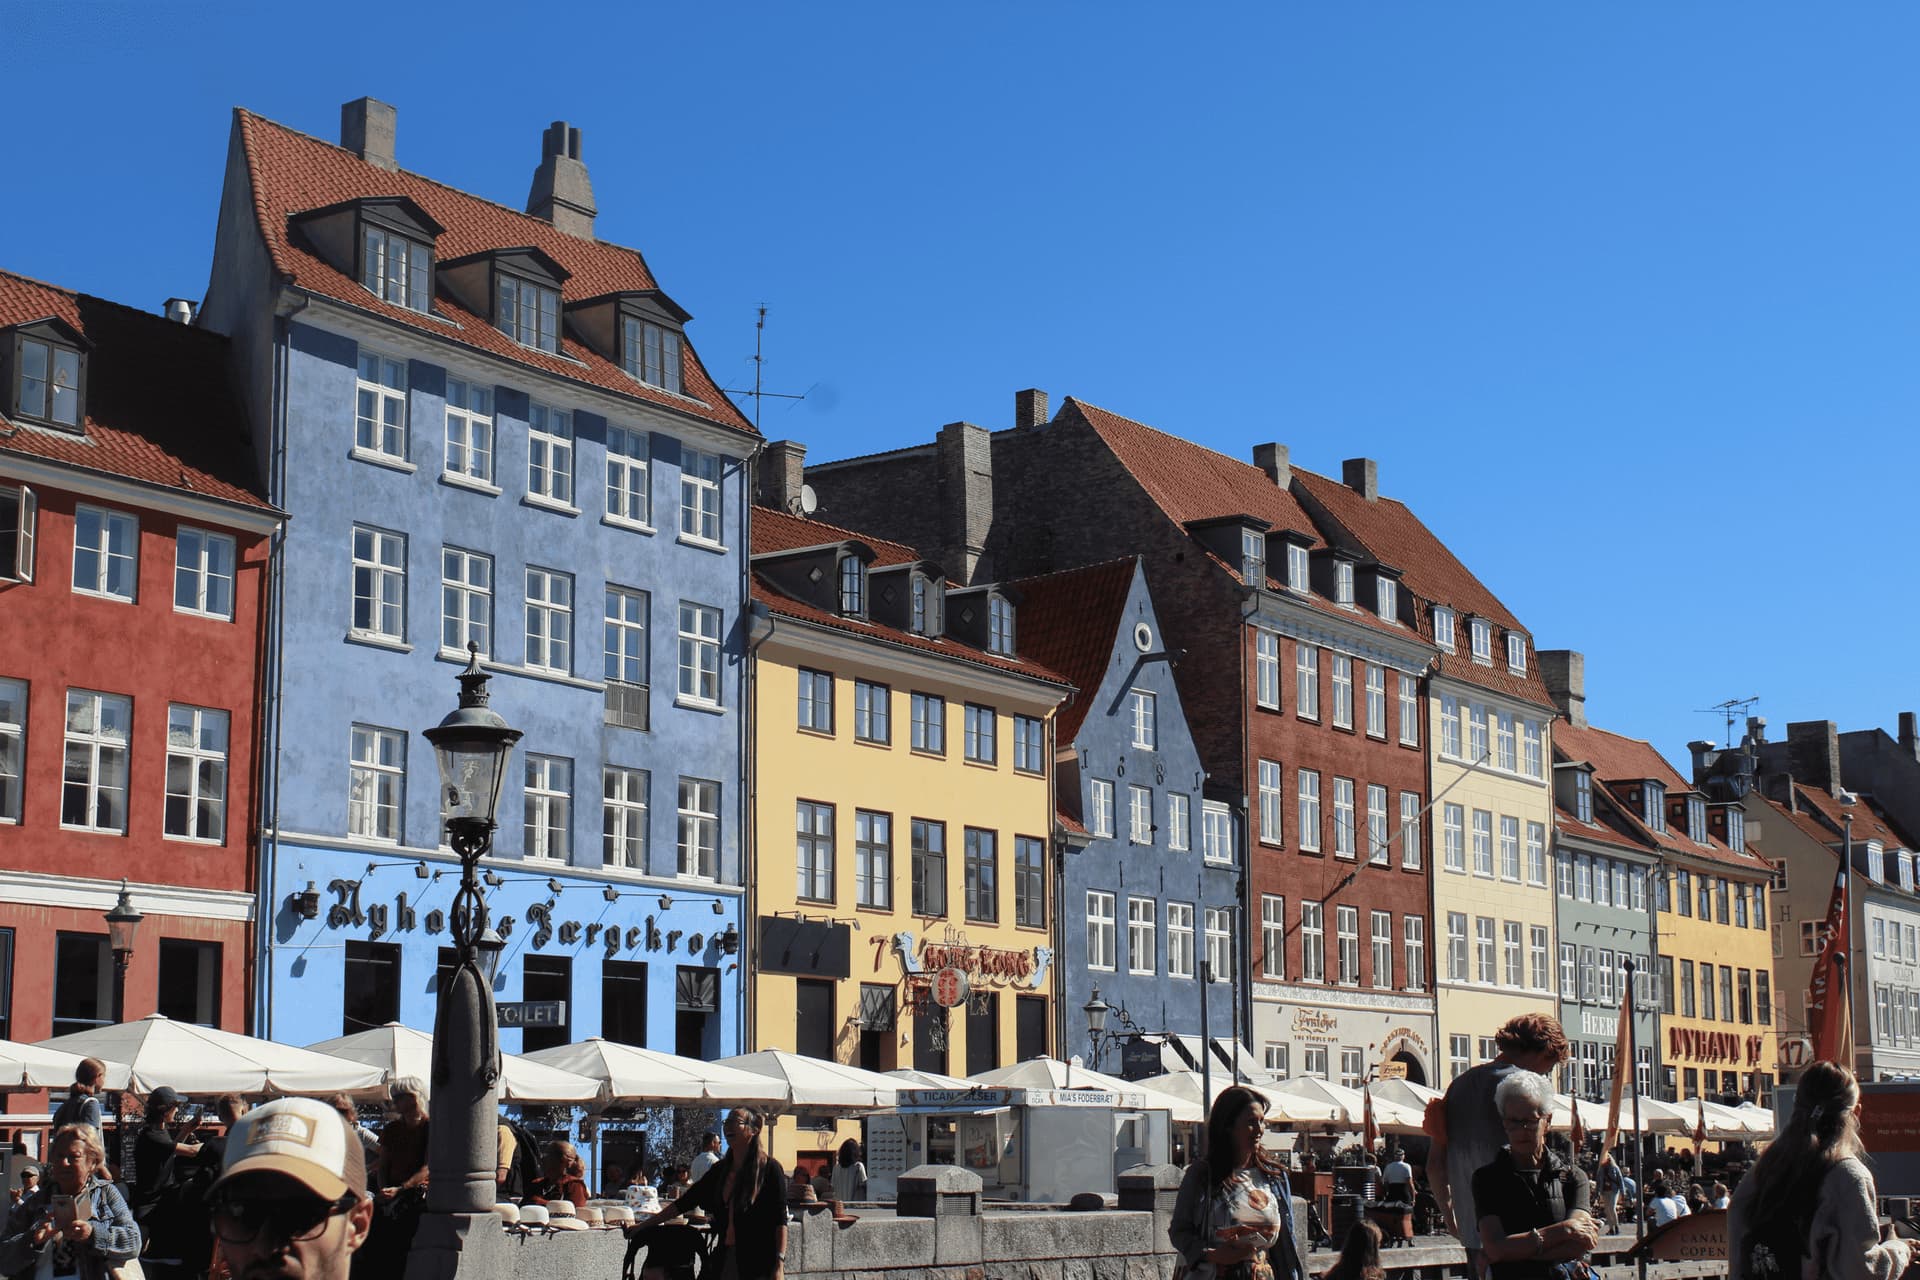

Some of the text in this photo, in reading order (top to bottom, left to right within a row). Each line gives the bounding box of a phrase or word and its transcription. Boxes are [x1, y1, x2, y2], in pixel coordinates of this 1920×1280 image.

[327, 879, 515, 941] Nyhas
[869, 935, 888, 972] 7
[1669, 1027, 1763, 1063] NYHAVN 17
[1781, 1041, 1804, 1066] 17
[923, 1092, 954, 1101] TICAN
[1060, 1093, 1076, 1102] MIA'S
[1681, 1233, 1726, 1243] CANAL
[1680, 1247, 1726, 1256] COPEN
